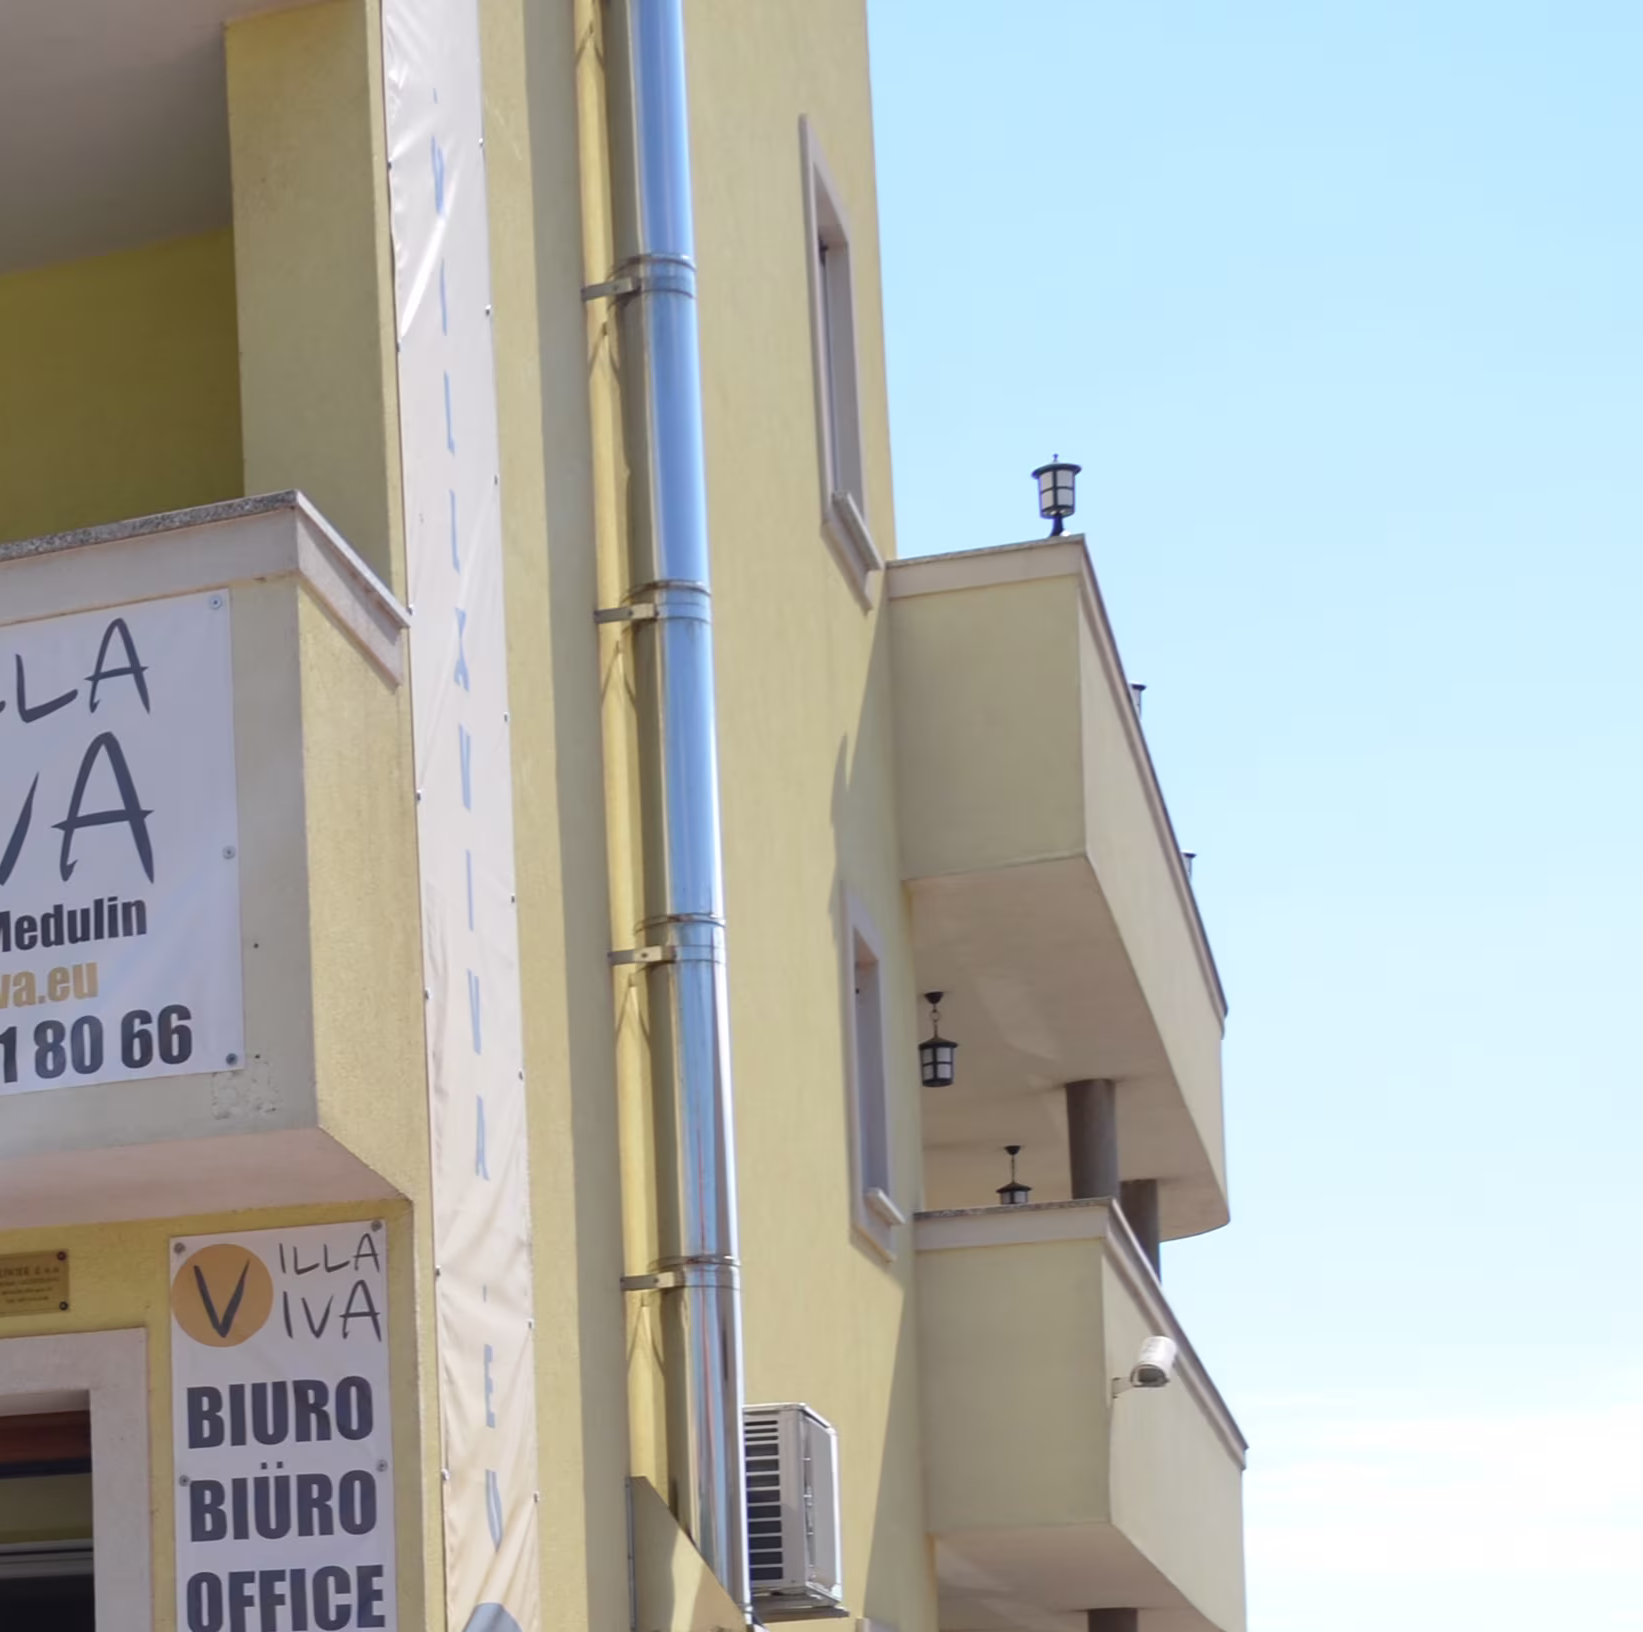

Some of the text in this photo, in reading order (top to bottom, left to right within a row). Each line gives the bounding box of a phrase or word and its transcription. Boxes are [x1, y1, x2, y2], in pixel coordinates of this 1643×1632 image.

[34, 1016, 103, 1079] 80
[121, 1005, 192, 1068] 66
[187, 1376, 373, 1449] BIURO
[190, 1462, 376, 1542] BIÜRO
